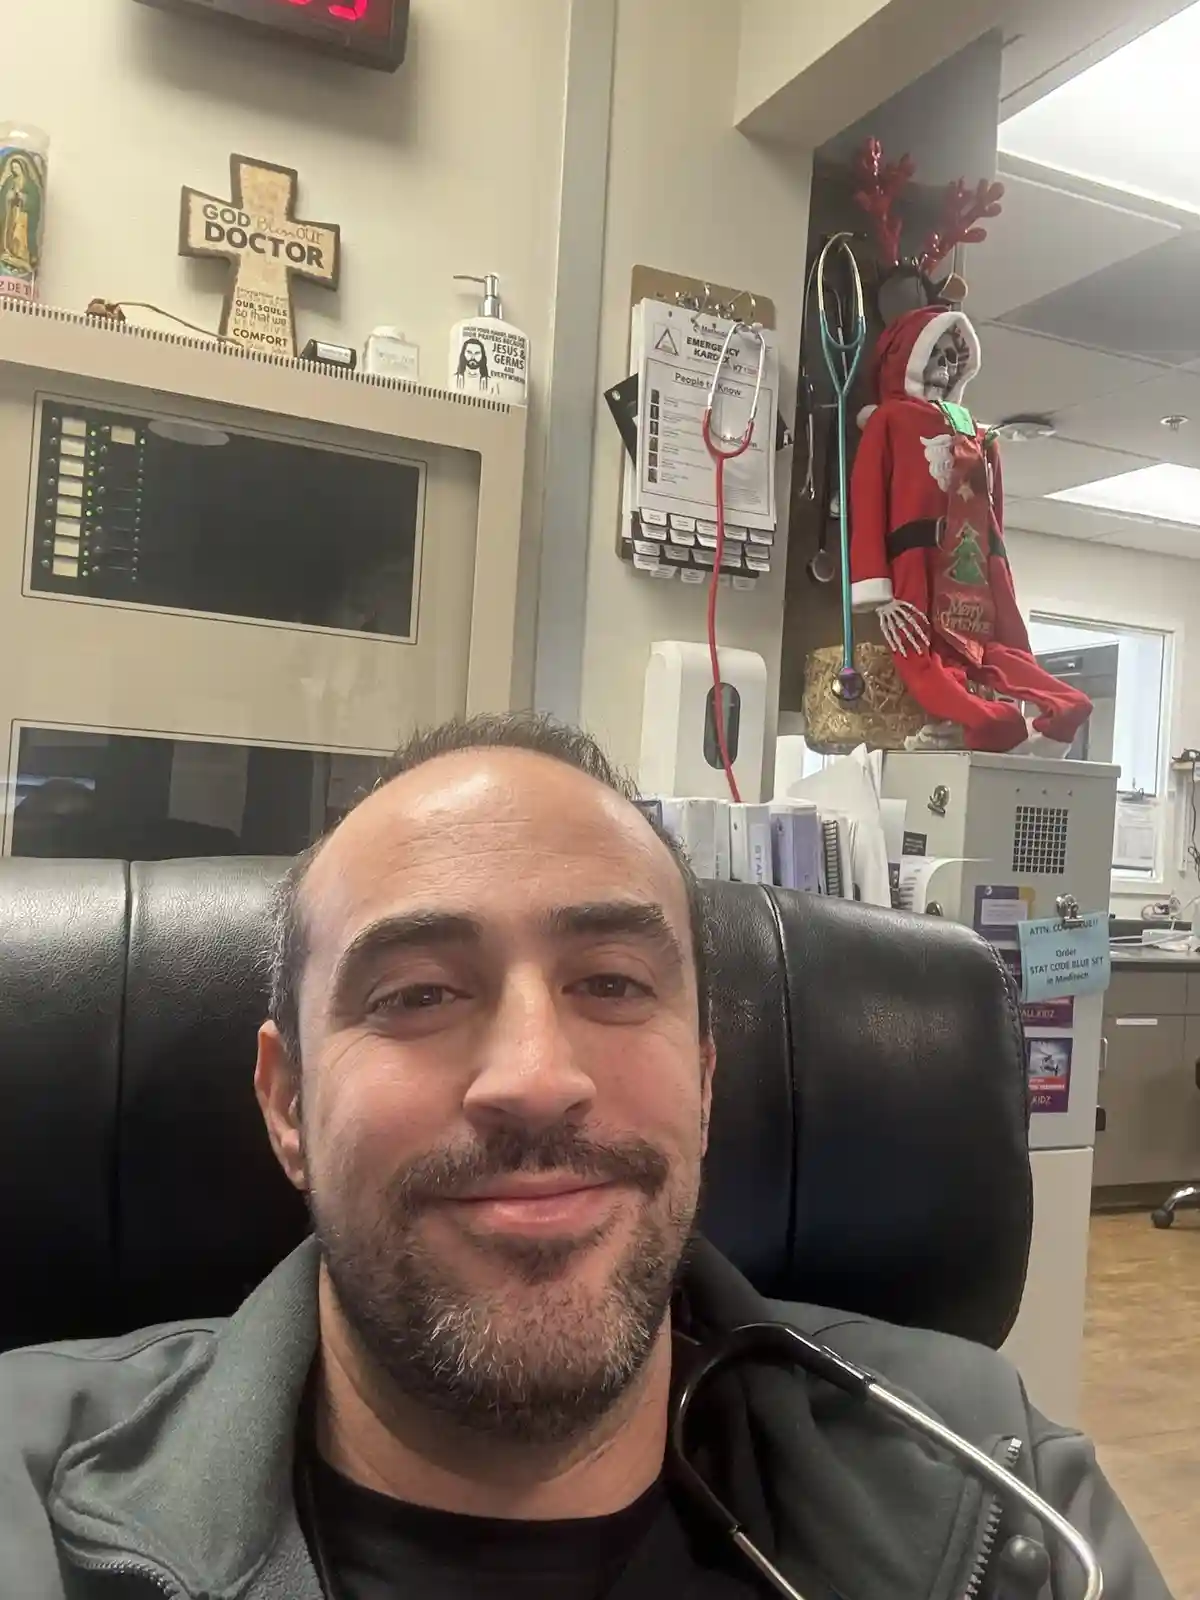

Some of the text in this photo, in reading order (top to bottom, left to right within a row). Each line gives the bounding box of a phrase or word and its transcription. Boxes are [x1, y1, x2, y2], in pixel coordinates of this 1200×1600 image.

[203, 204, 250, 227] GOD
[205, 221, 325, 269] DOCTOR
[8, 282, 21, 293] DE
[235, 299, 288, 316] OUR SOULS
[233, 328, 288, 347] COMFORT
[492, 342, 526, 360] JESUS &
[686, 336, 740, 357] EMERGECY
[494, 354, 525, 370] GERMS
[694, 349, 730, 364] KARDX
[675, 372, 707, 387] People
[718, 384, 742, 396] Know
[1056, 948, 1077, 957] Order
[1030, 964, 1048, 974] STAT
[1050, 962, 1070, 972] CODE
[1072, 958, 1089, 968] BLUE
